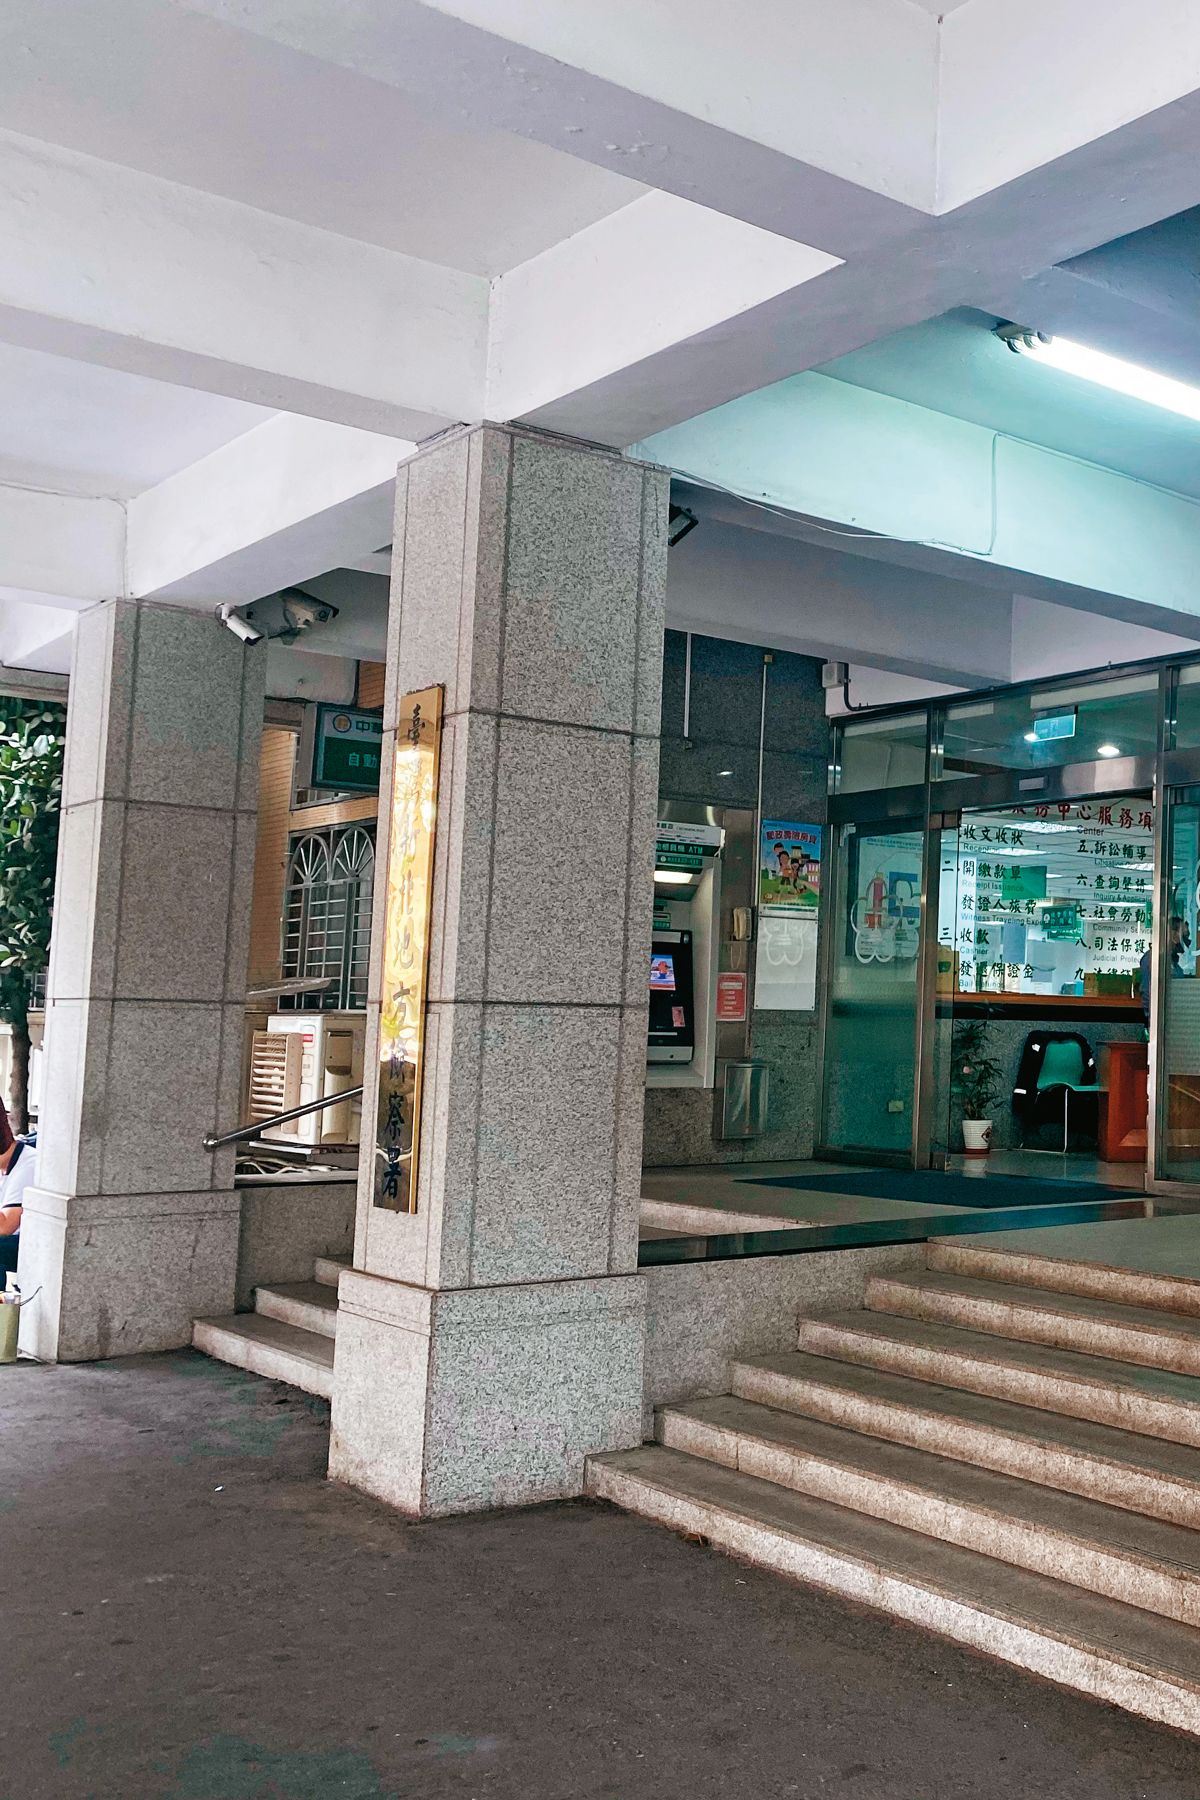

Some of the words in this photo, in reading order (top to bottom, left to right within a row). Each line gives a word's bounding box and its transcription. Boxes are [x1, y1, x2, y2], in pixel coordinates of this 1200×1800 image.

[348, 752, 378, 768] 自動
[1077, 824, 1105, 836] Center
[688, 846, 703, 854] ATM
[1093, 892, 1115, 902] Inquiry
[1092, 923, 1129, 934] Community
[960, 946, 988, 955] Cashier
[1092, 954, 1118, 962] Judicial
